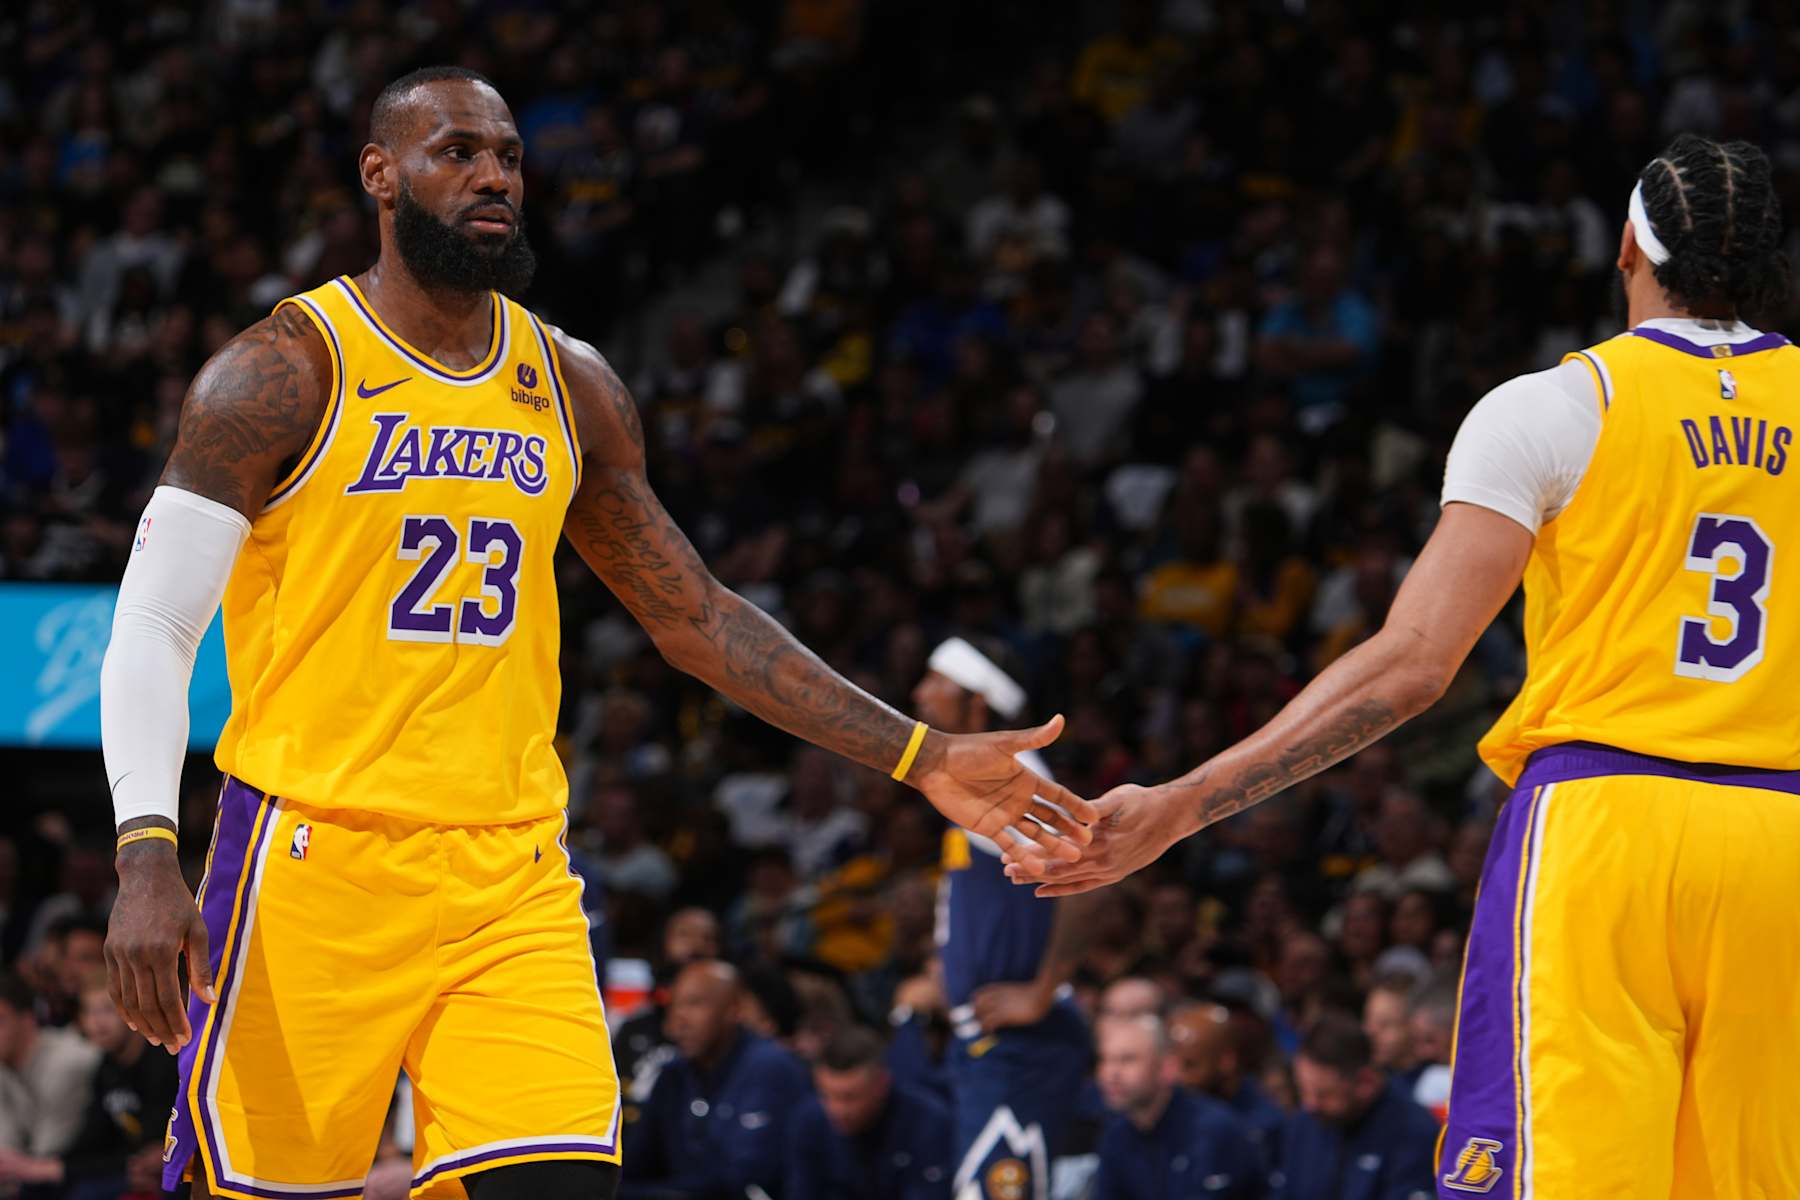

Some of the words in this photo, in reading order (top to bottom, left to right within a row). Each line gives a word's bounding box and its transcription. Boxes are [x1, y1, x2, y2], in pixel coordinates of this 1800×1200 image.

[510, 387, 550, 412] bibigo
[343, 412, 549, 496] LAKERS
[1680, 415, 1793, 476] DAVIS
[387, 514, 525, 647] 23
[1673, 512, 1776, 684] 3
